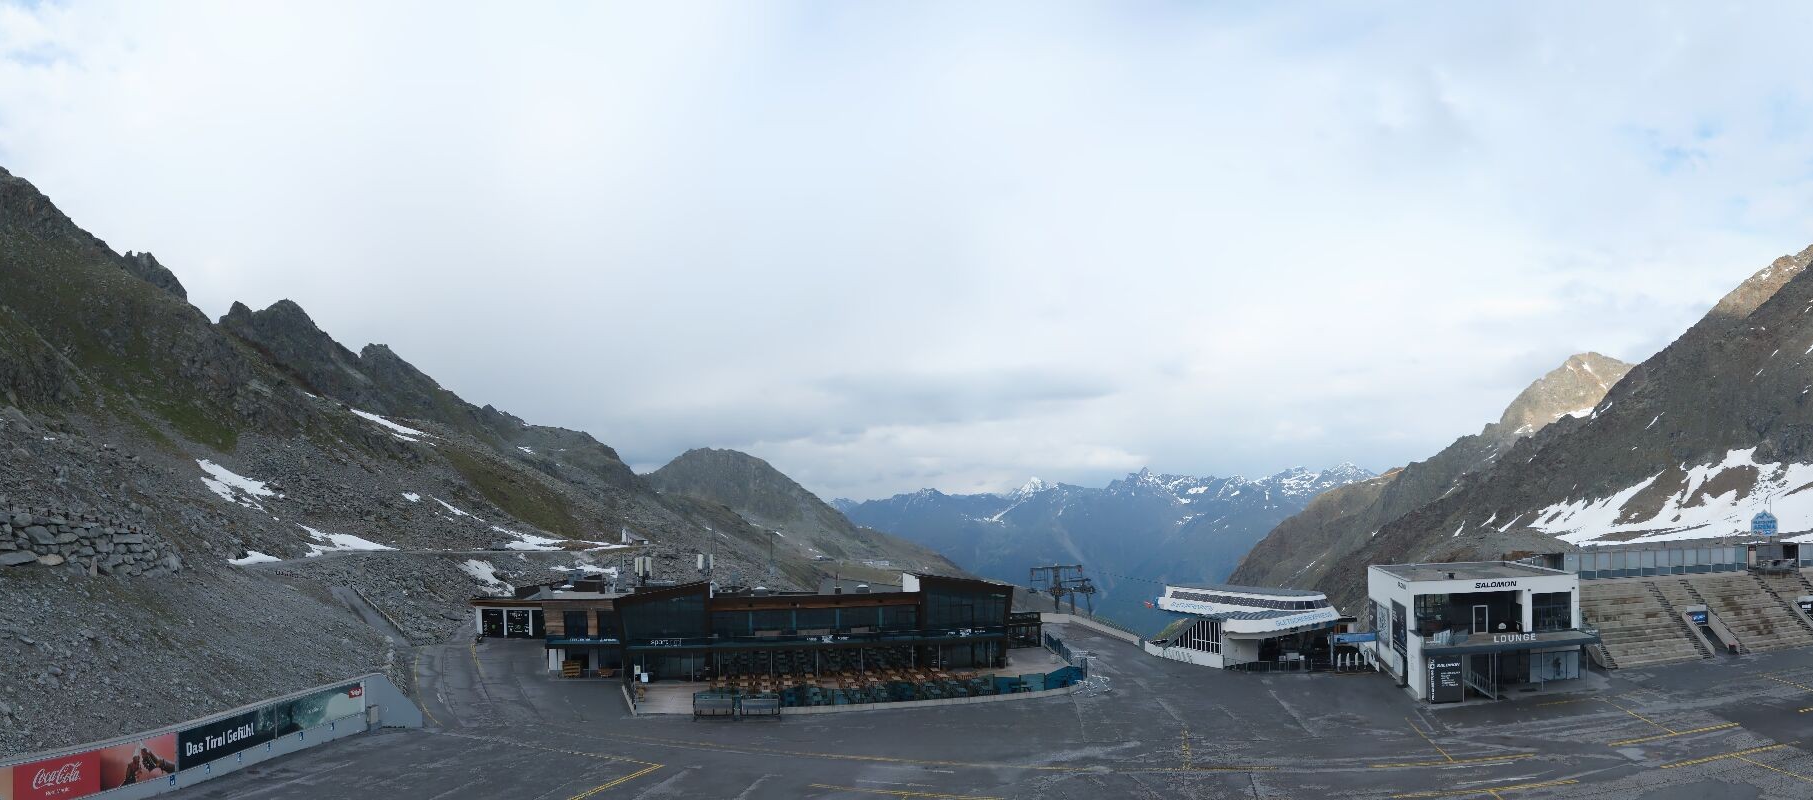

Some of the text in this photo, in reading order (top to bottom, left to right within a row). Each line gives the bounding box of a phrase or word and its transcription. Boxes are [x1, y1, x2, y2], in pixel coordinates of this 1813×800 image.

[1475, 581, 1517, 589] SALOMON
[1493, 633, 1537, 643] LOUNGE
[186, 722, 255, 757] Das Tirol Gefühl
[32, 761, 83, 790] Coca-Cola
